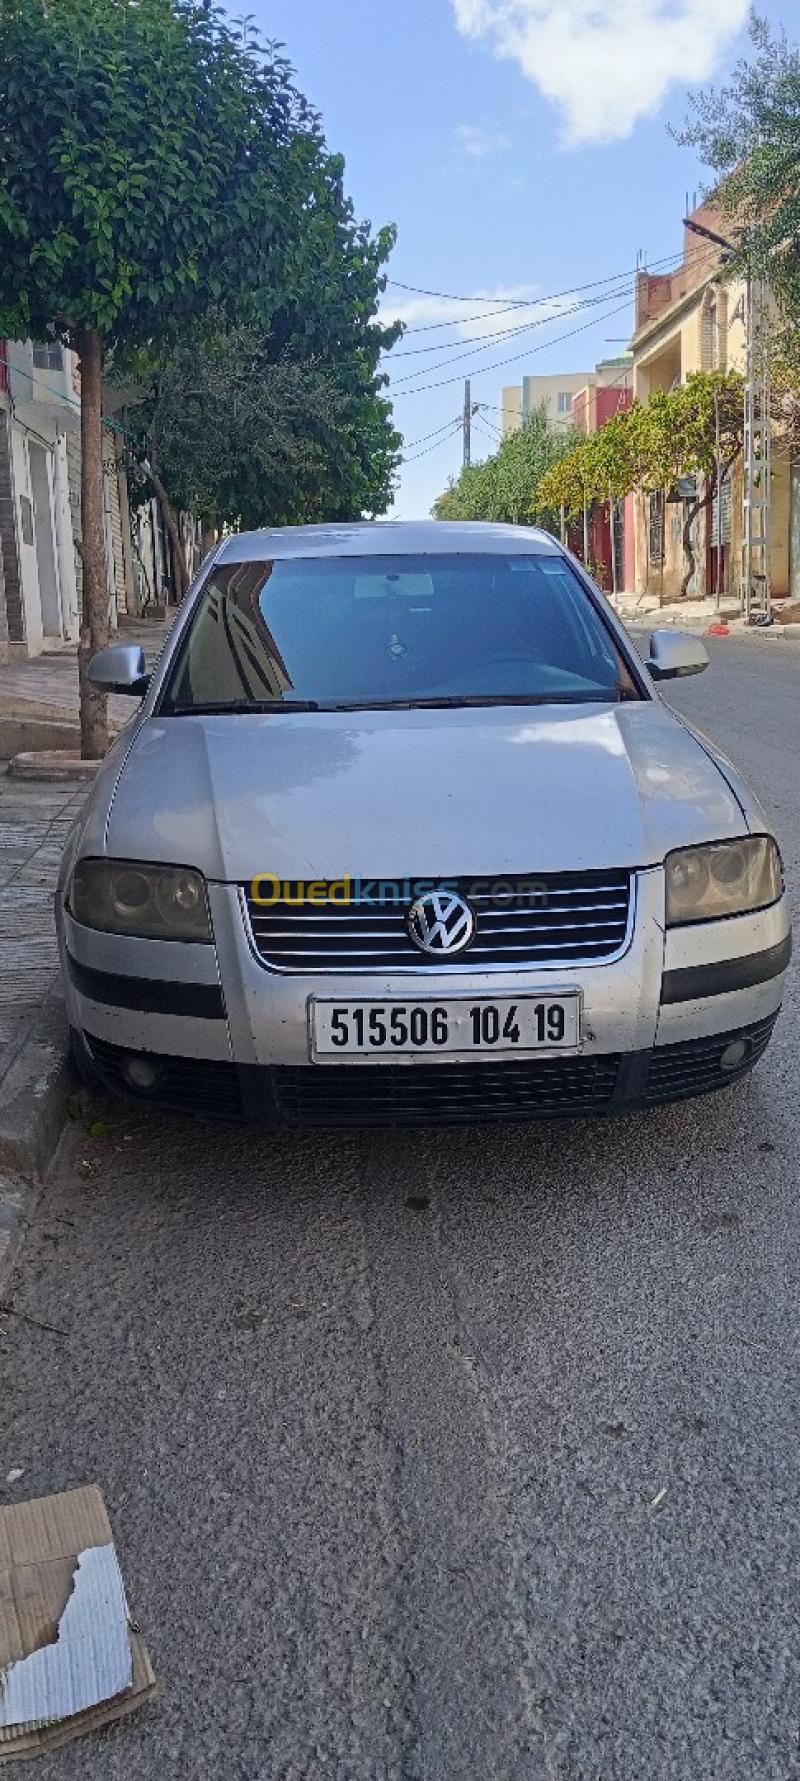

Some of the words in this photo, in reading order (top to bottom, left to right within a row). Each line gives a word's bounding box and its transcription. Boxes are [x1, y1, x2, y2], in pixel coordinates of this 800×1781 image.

[330, 1008, 448, 1047] 515506
[469, 1005, 521, 1045] 104
[534, 1003, 565, 1042] 19
